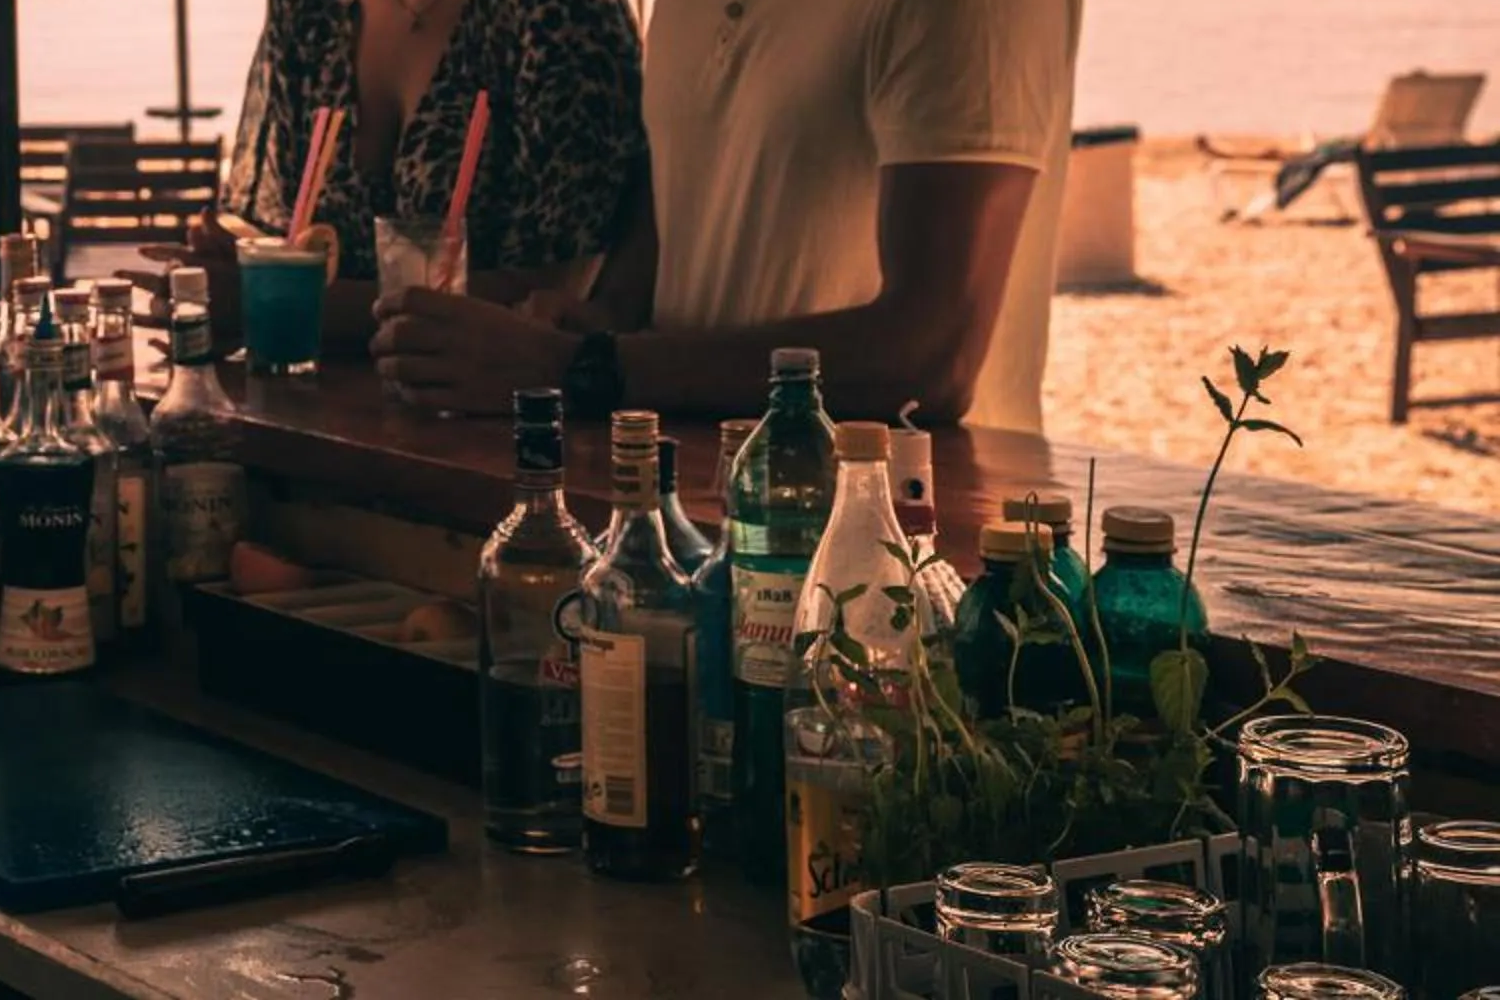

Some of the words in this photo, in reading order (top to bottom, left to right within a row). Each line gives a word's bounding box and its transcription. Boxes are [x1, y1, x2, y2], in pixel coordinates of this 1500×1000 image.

[18, 511, 83, 529] MONIN
[756, 588, 793, 602] 1828
[739, 612, 793, 642] Jamn
